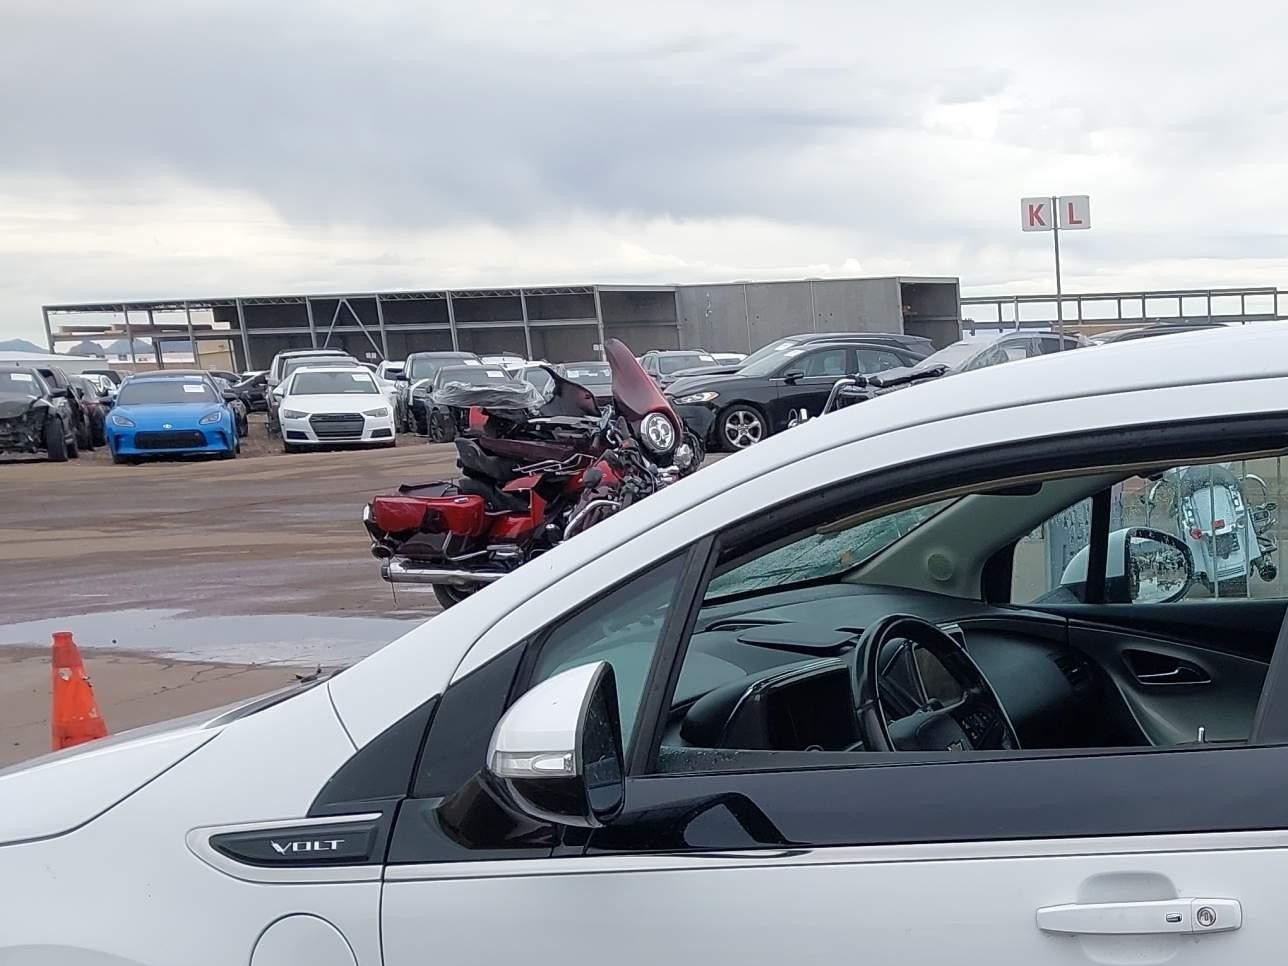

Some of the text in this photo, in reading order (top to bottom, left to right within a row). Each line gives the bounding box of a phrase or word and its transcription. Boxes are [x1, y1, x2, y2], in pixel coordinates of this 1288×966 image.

[1028, 202, 1083, 227] K L
[270, 839, 345, 856] VOLT
